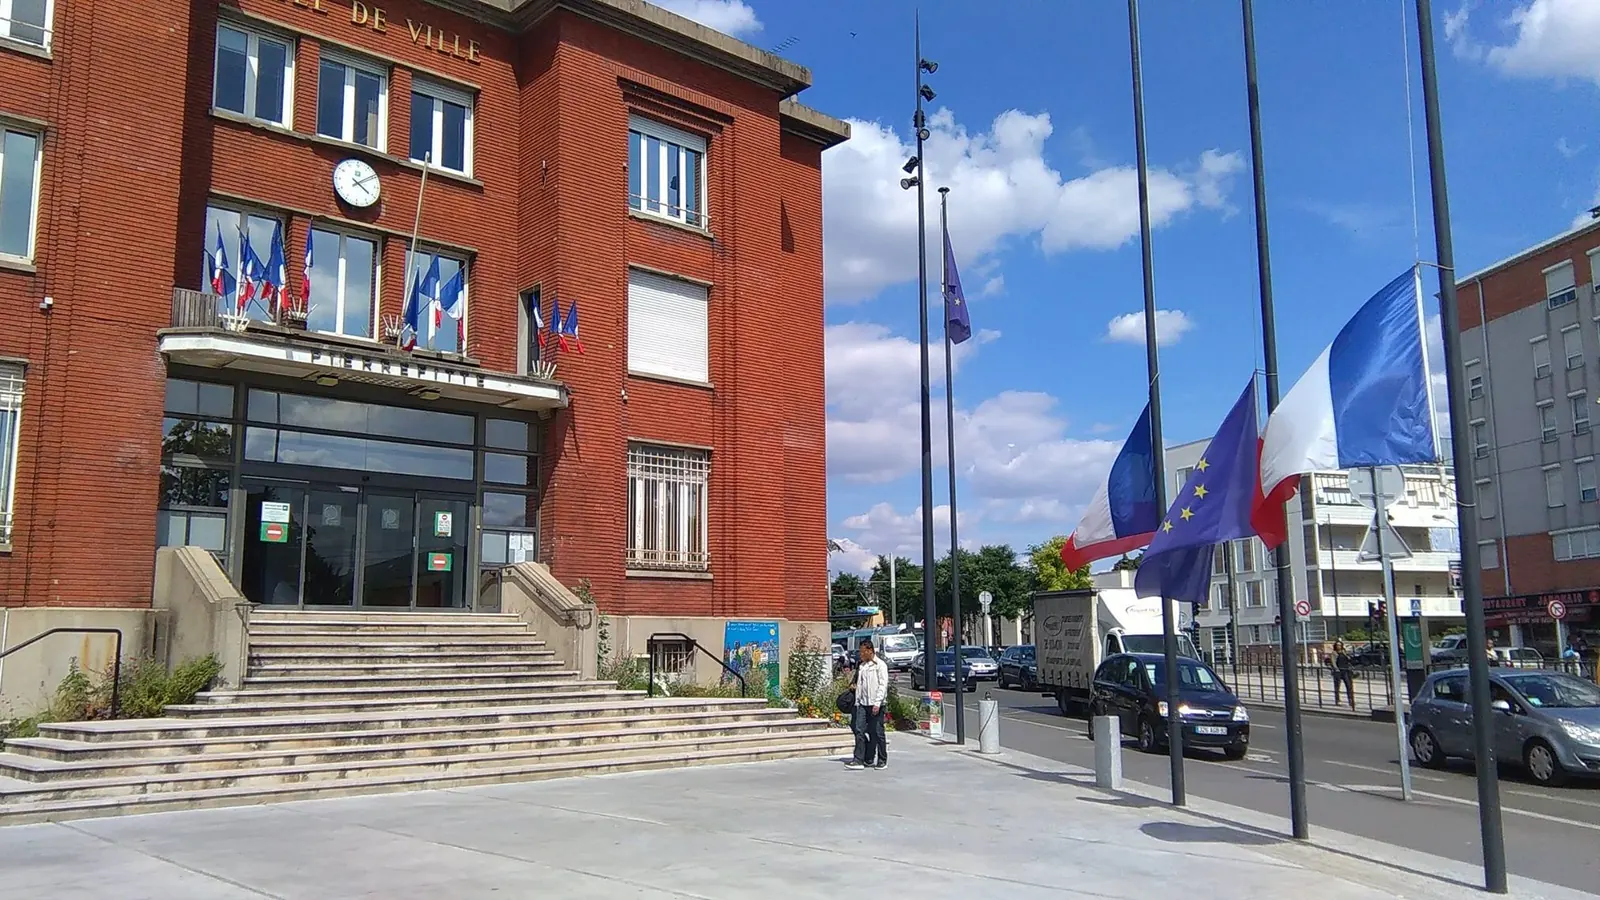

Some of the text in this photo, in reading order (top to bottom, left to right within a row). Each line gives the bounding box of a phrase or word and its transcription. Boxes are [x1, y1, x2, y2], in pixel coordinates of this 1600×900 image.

[351, 1, 481, 64] DE VILLE
[311, 349, 485, 387] PIERREFITTE
